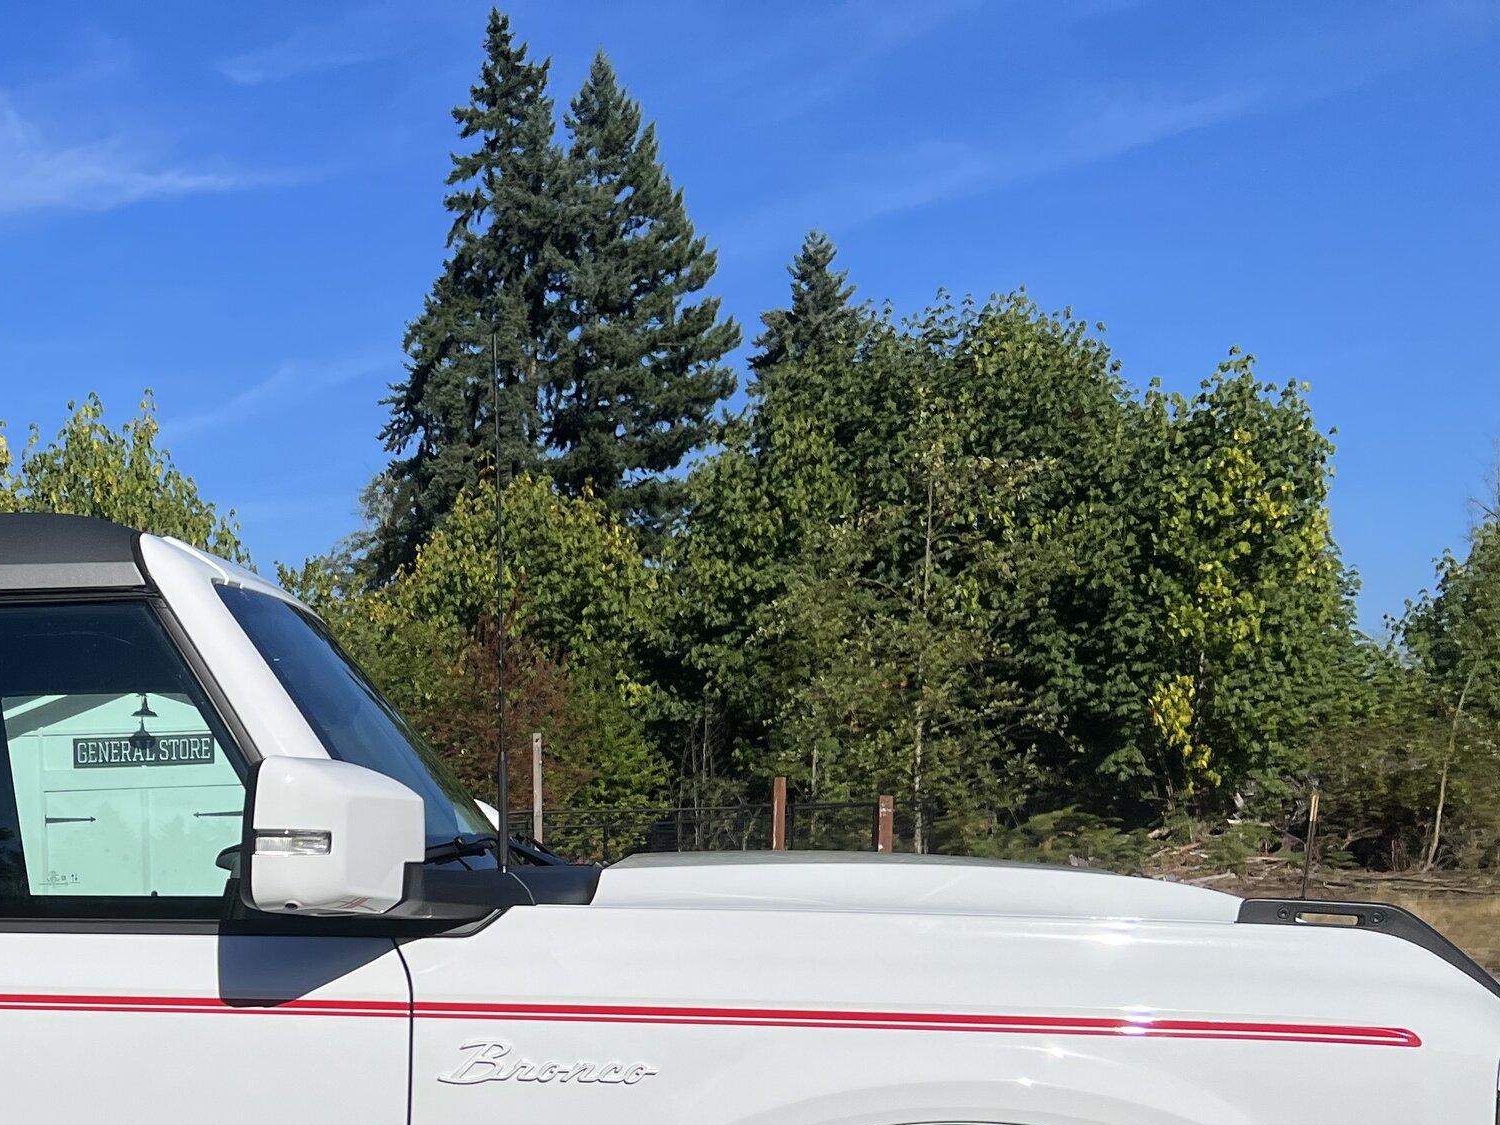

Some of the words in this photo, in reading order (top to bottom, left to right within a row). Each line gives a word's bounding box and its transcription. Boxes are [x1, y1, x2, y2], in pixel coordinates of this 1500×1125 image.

[77, 741, 155, 763] GENERAL
[159, 738, 211, 761] STORE
[436, 1039, 659, 1085] Bronco
